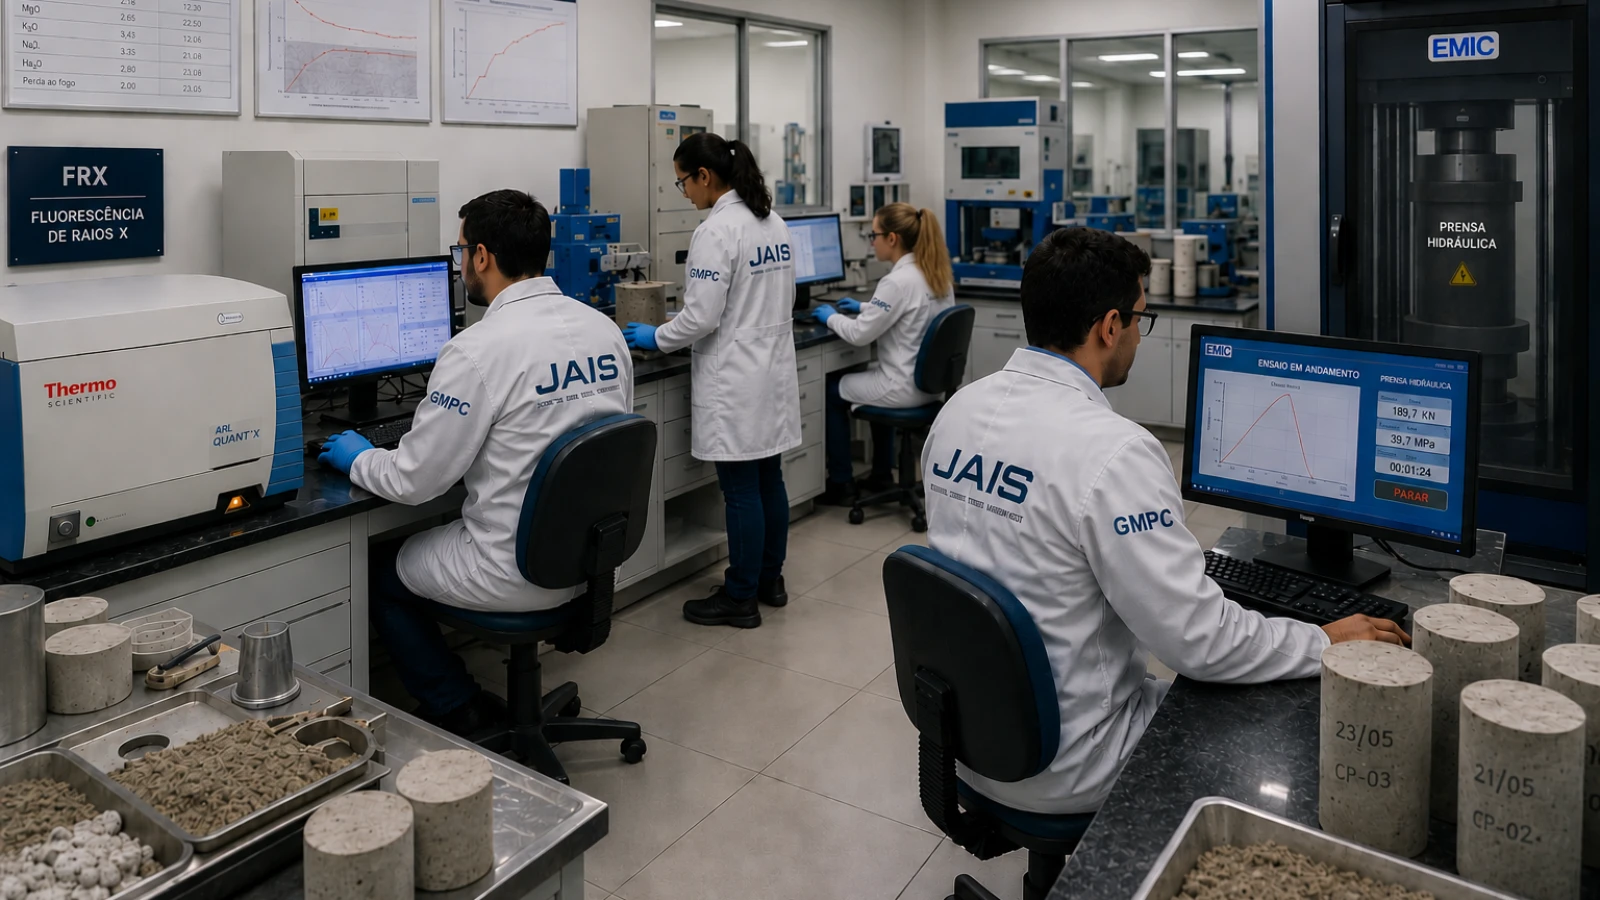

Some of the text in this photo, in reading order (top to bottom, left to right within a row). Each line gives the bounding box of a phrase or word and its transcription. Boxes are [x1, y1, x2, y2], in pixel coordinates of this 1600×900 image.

[22, 4, 41, 15] MgO
[1433, 35, 1495, 58] EMIC
[22, 76, 46, 86] Perda
[58, 78, 76, 88] fogo
[62, 166, 109, 187] FRX
[31, 206, 145, 224] FLUORESCÊNCIA
[48, 227, 128, 244] DE RAIOS X
[1440, 222, 1486, 233] PRENSA
[1427, 236, 1497, 249] HIDRÁULICA
[749, 243, 791, 268] JAIS
[689, 268, 720, 281] GMPC
[1205, 344, 1231, 356] EMIC
[535, 353, 619, 396] JAIS
[1258, 358, 1360, 379] ENSAIO EM ANDAMENTO
[44, 378, 117, 399] Thermo
[1380, 375, 1408, 386] PRENSA
[48, 392, 116, 408] SCIENTIFIC
[430, 391, 471, 416] GMPC
[1393, 406, 1436, 421] 189,7 KN
[215, 423, 233, 434] ARL
[1414, 437, 1435, 449] MPa
[932, 448, 1034, 505] JAIS
[1389, 462, 1431, 477] 00:01:24
[1393, 487, 1429, 503] PARAR
[1113, 508, 1174, 536] GMPC
[1335, 720, 1394, 749] 23/05
[1334, 763, 1392, 789] CP-03
[1474, 763, 1535, 798] 21/05
